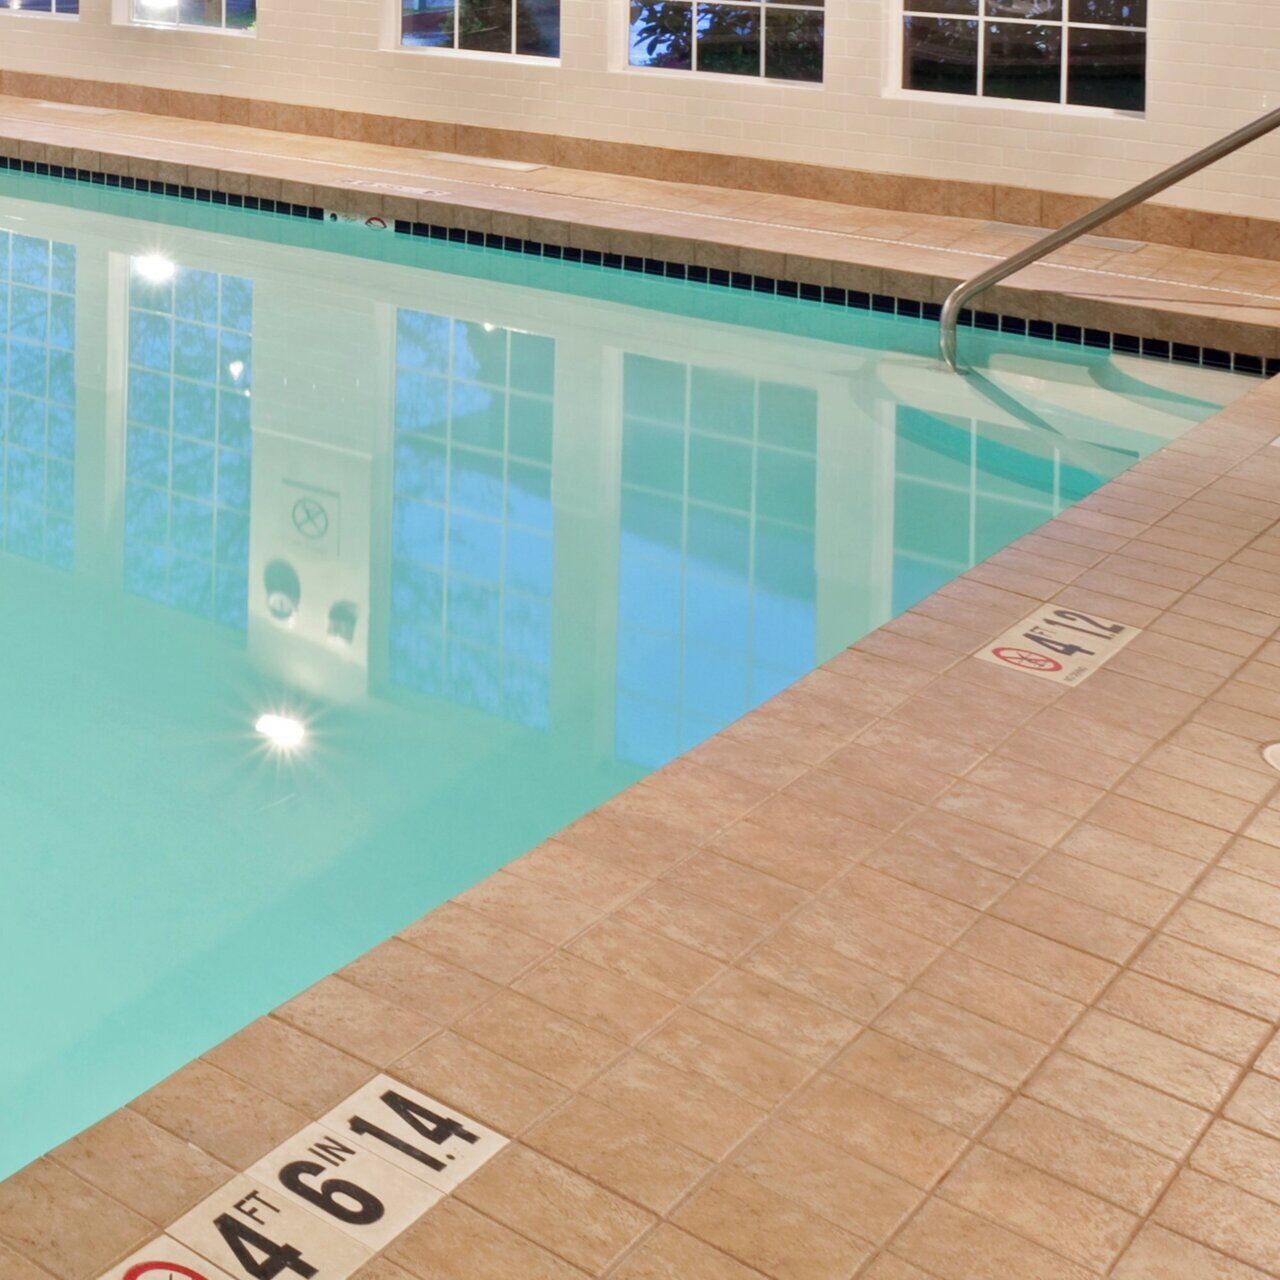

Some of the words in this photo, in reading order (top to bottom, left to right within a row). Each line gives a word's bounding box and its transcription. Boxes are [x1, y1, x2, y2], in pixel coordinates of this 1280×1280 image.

[1023, 632, 1095, 656] 4
[307, 1135, 356, 1167] IN
[347, 1089, 481, 1172] 1.4
[233, 1190, 281, 1225] FT
[278, 1159, 386, 1226] 6
[213, 1212, 319, 1280] 4
